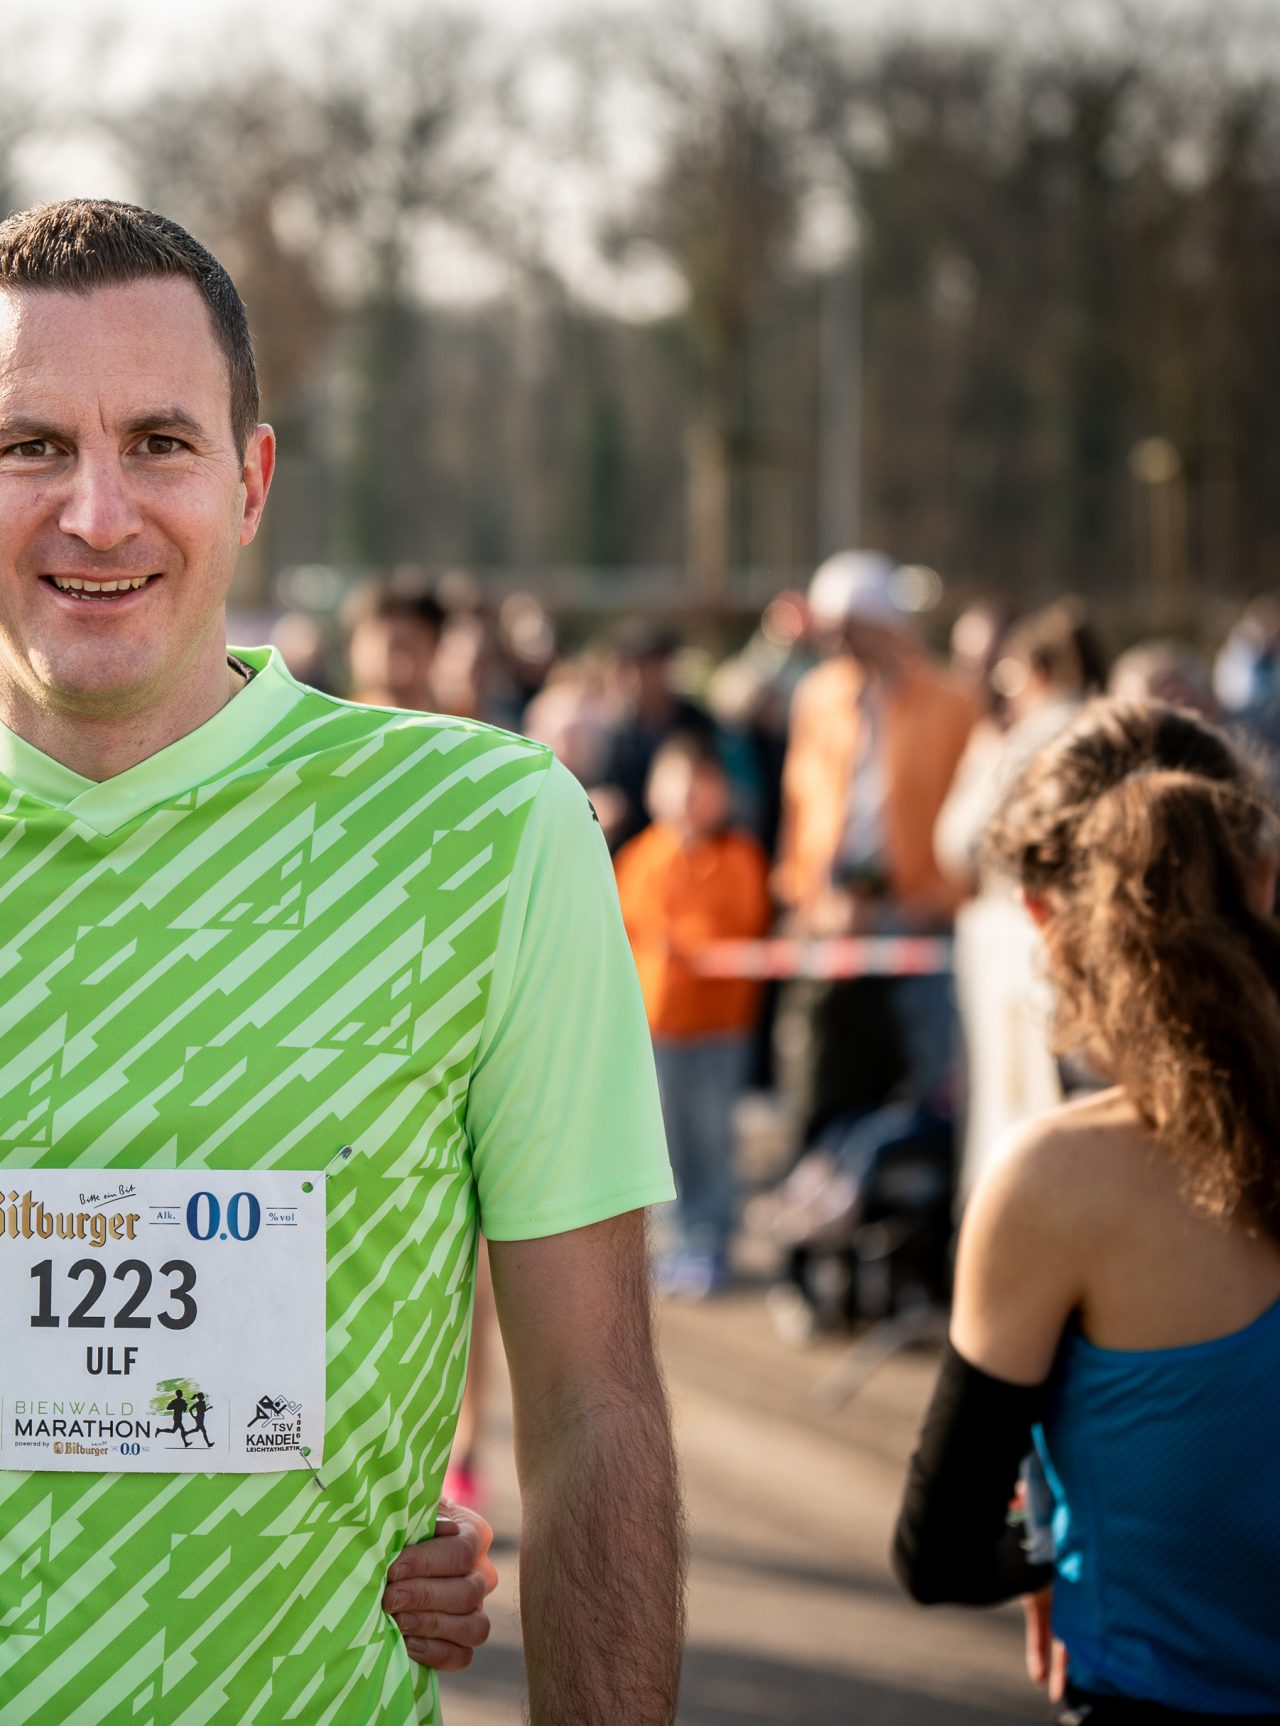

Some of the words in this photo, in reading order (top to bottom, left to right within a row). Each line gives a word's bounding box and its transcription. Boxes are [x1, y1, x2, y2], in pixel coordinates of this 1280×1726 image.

[79, 1193, 101, 1205] Bitte
[103, 1192, 117, 1201] ein
[118, 1184, 136, 1196] Bit
[156, 1212, 176, 1220] Alk.
[186, 1191, 261, 1242] 0.0
[30, 1258, 198, 1330] 1223
[86, 1346, 138, 1375] ULF
[15, 1400, 134, 1416] BIENWALD
[15, 1418, 151, 1439] MARATHON
[272, 1423, 293, 1432] TSV
[246, 1433, 300, 1446] KANDEL
[65, 1441, 109, 1457] Bitburger
[120, 1442, 141, 1456] 0.0
[246, 1445, 301, 1453] LEICHTATHLETIK
